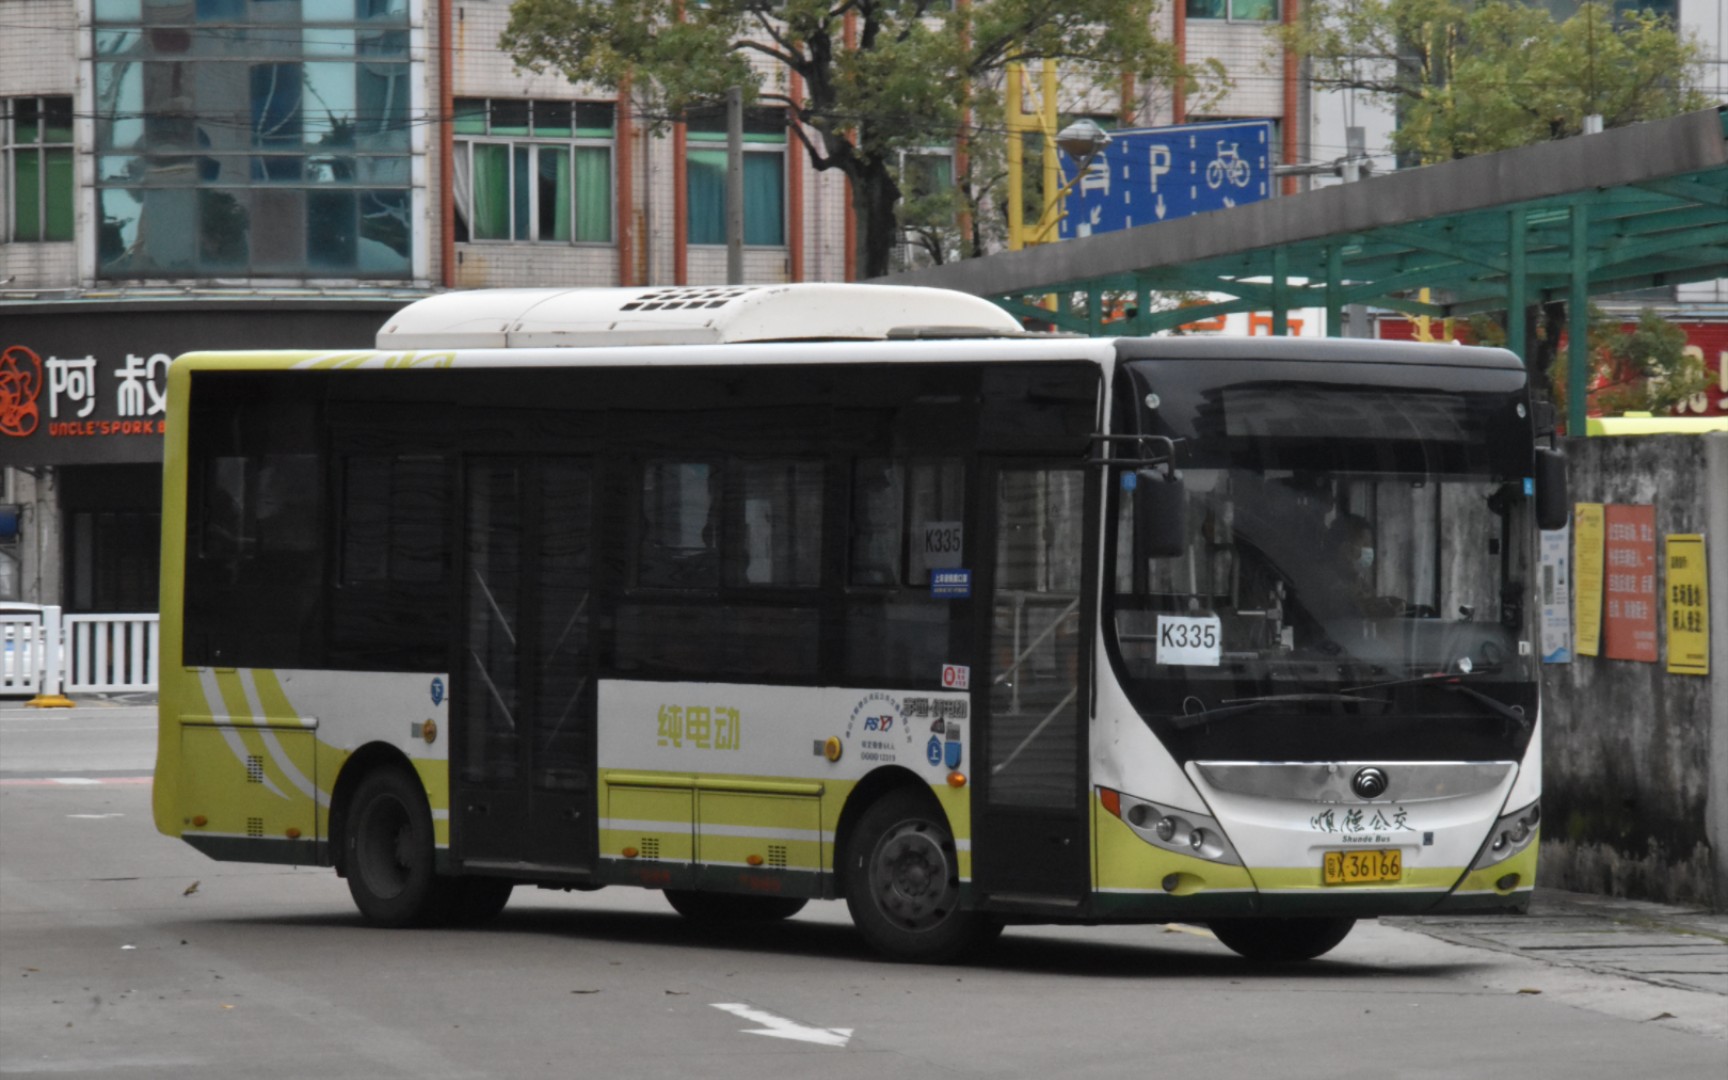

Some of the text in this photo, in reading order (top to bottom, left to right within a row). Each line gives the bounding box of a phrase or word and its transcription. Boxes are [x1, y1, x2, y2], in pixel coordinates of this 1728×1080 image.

[1150, 144, 1170, 193] P
[926, 528, 960, 552] K335
[1161, 623, 1215, 648] K335
[657, 703, 740, 750] 纯电动
[1342, 835, 1391, 843] Shunde Bus
